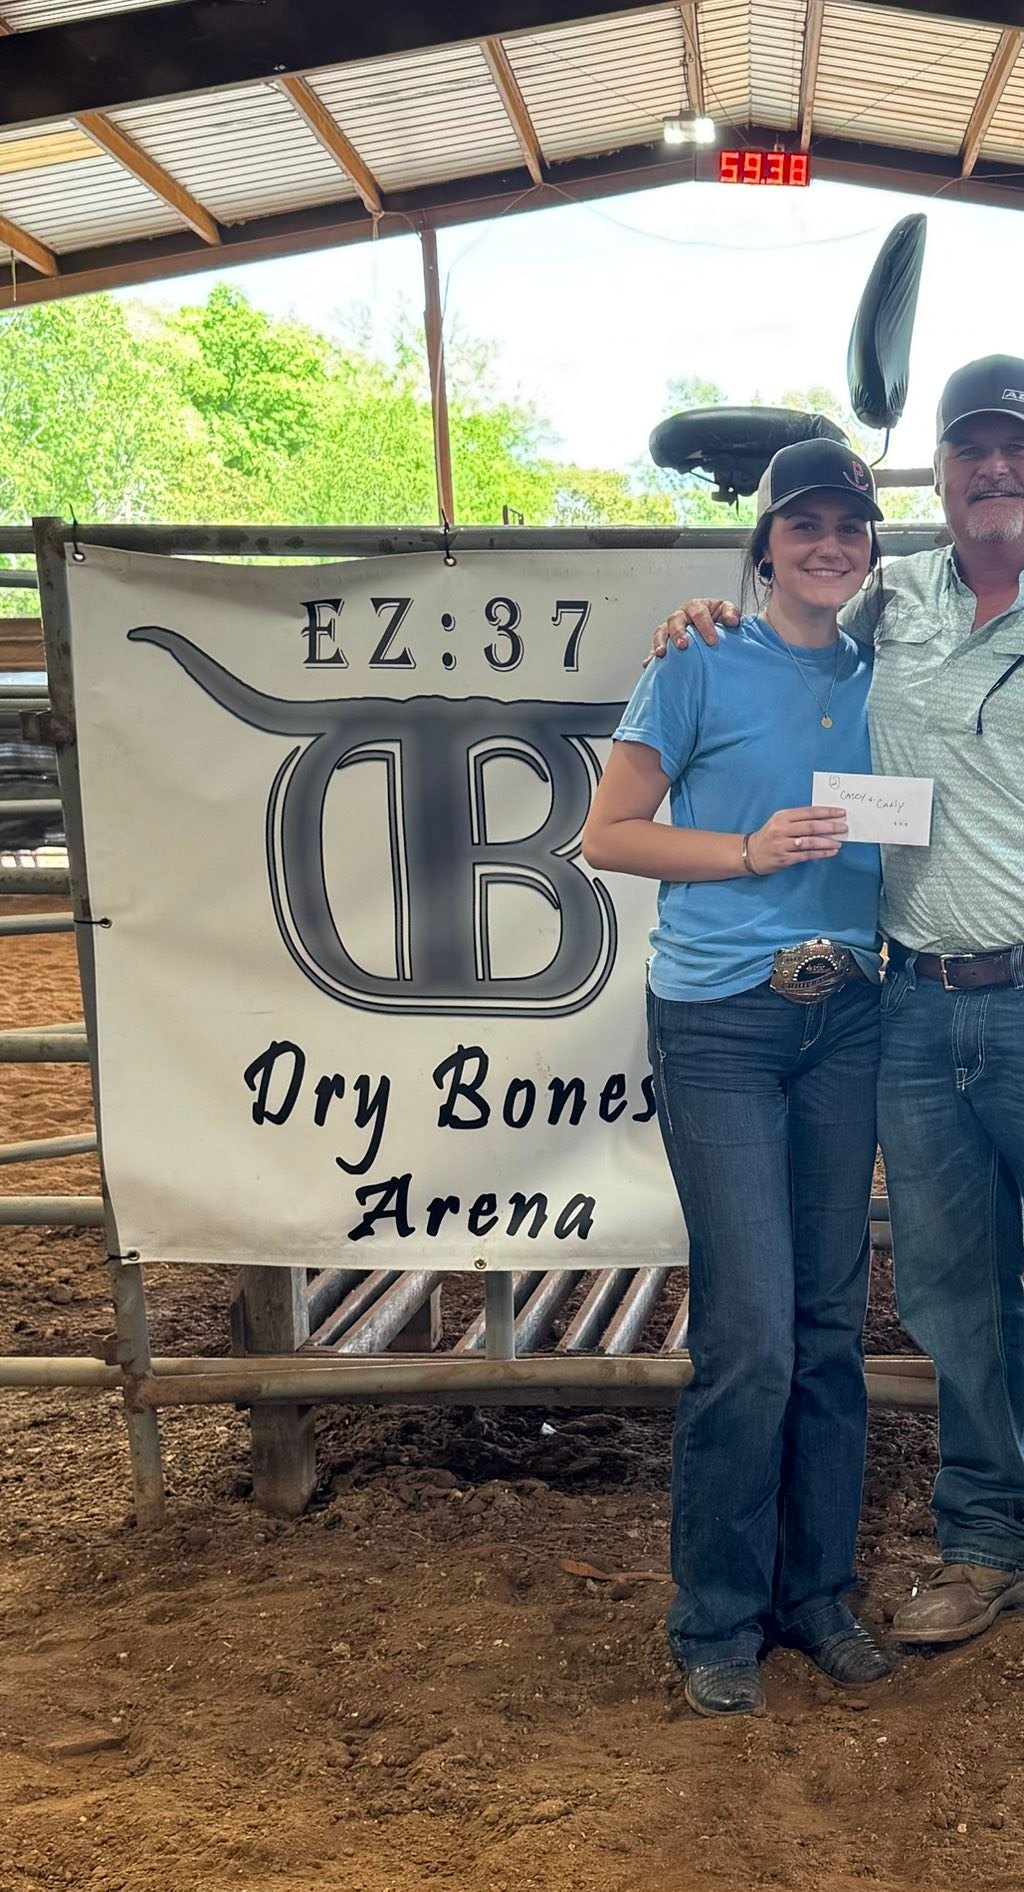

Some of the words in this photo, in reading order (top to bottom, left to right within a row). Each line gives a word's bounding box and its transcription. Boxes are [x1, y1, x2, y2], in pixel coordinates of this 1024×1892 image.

[720, 151, 808, 186] 59.38
[300, 596, 592, 673] EZ:37
[244, 1040, 391, 1175] Dry
[433, 1043, 657, 1130] Bones
[348, 1172, 596, 1242] Arena
